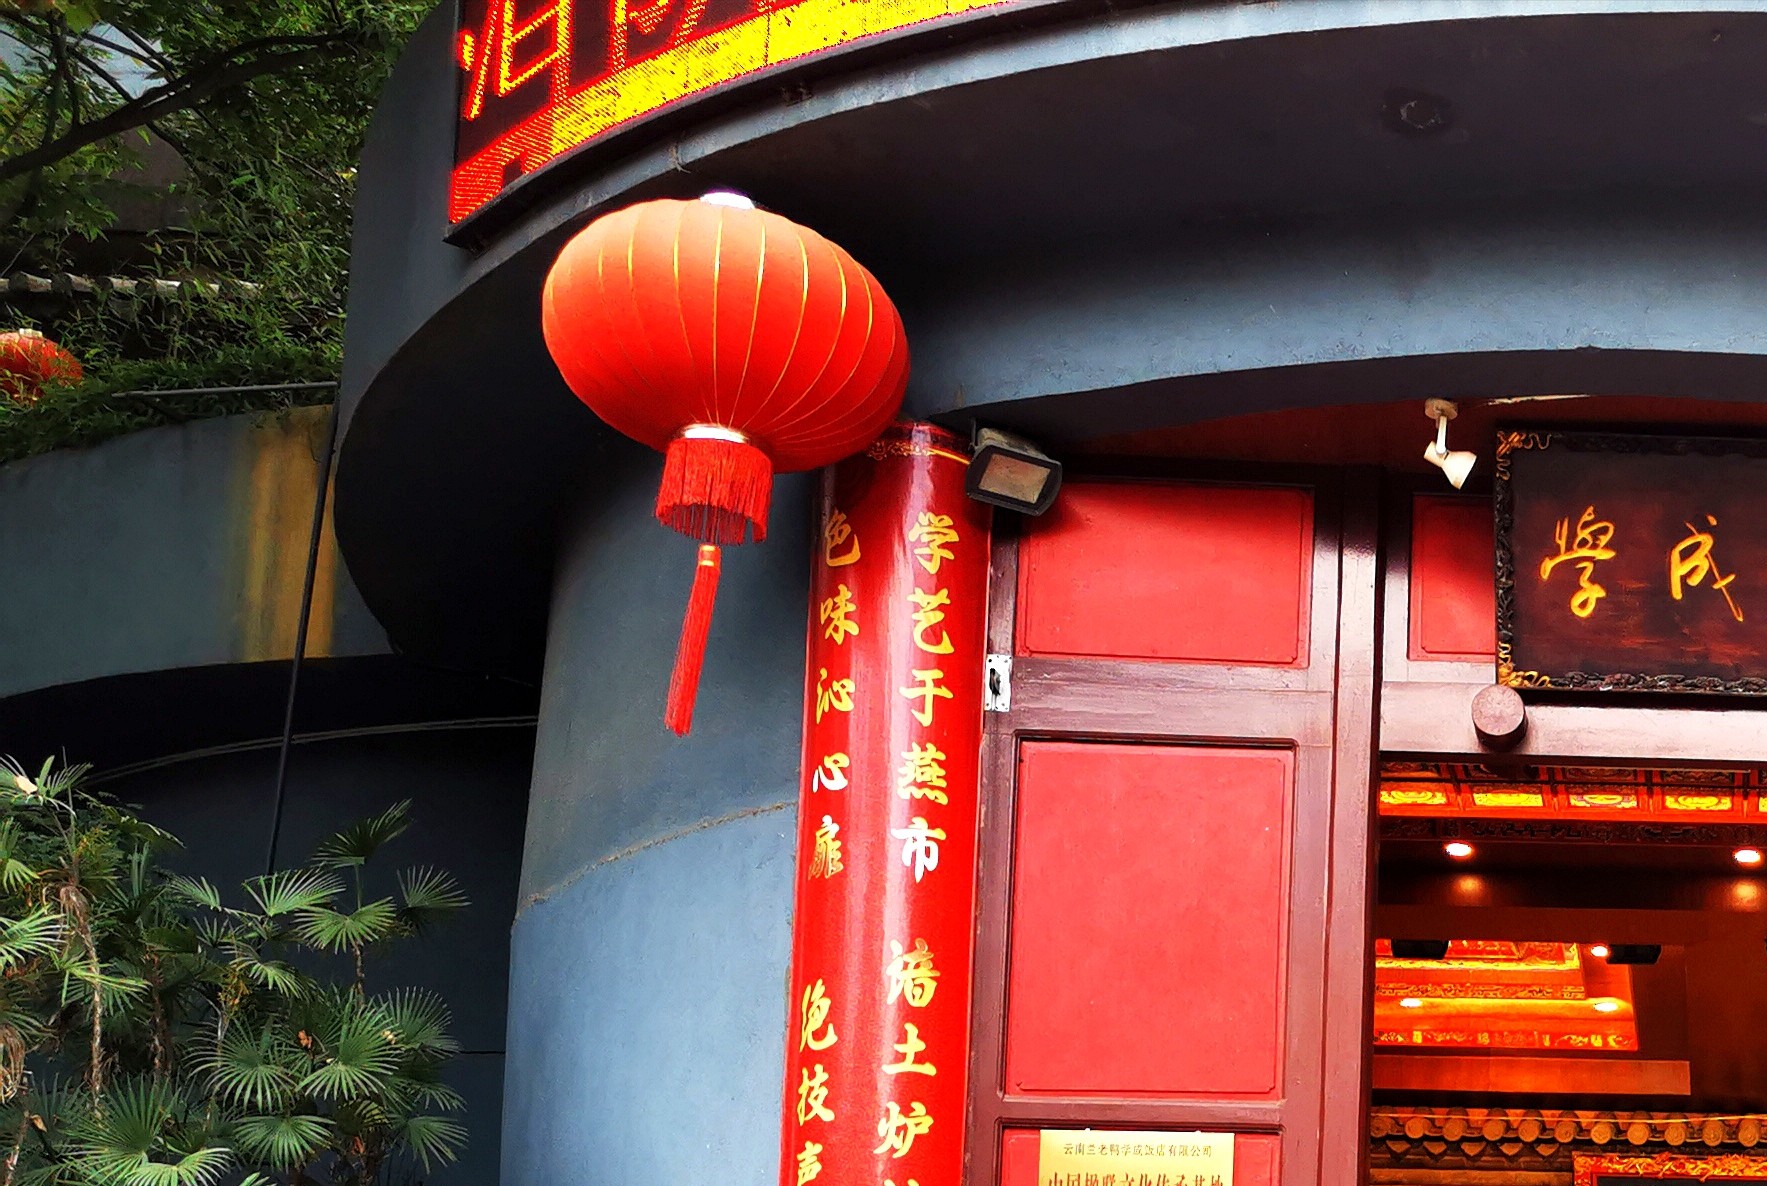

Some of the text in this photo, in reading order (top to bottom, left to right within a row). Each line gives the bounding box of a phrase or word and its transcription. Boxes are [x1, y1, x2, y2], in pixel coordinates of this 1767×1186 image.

[807, 508, 862, 881] 色味沁心扉
[890, 510, 960, 885] 学艺于燕市
